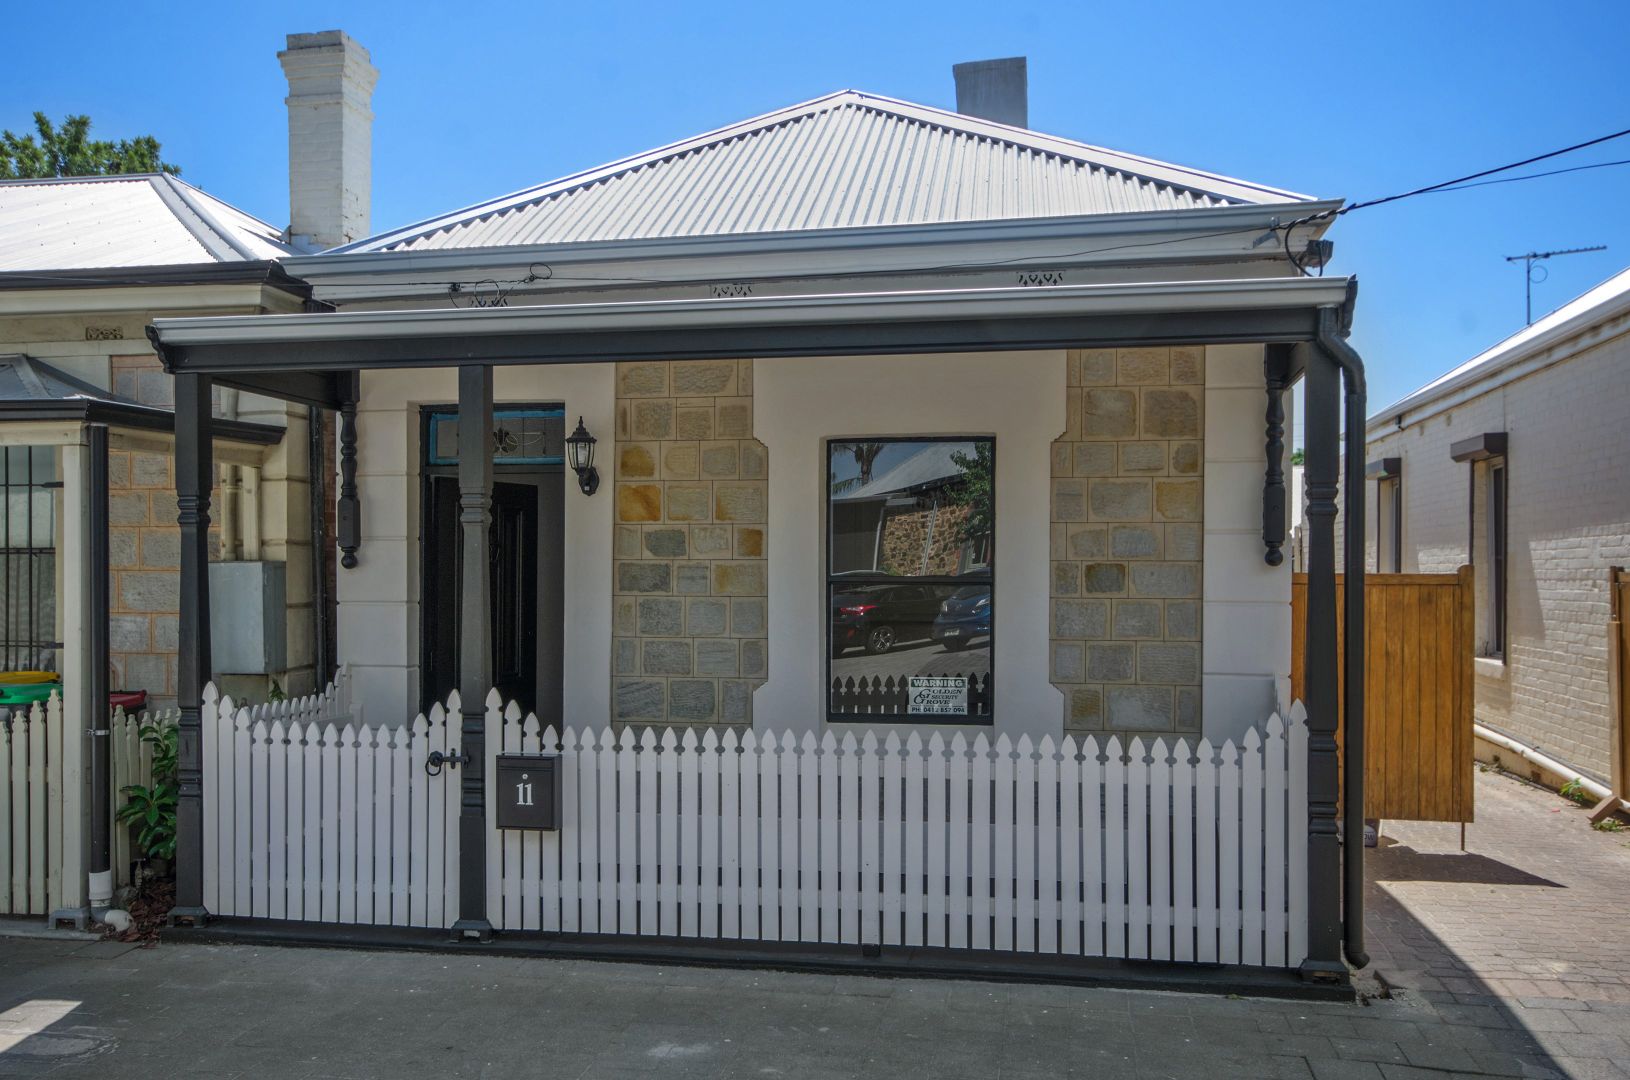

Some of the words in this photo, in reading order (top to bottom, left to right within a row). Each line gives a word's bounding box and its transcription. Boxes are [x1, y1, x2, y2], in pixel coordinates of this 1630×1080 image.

[913, 679, 963, 687] WARNING
[920, 688, 962, 698] GOLDEN
[914, 694, 950, 704] GROVE
[516, 782, 534, 806] 11
